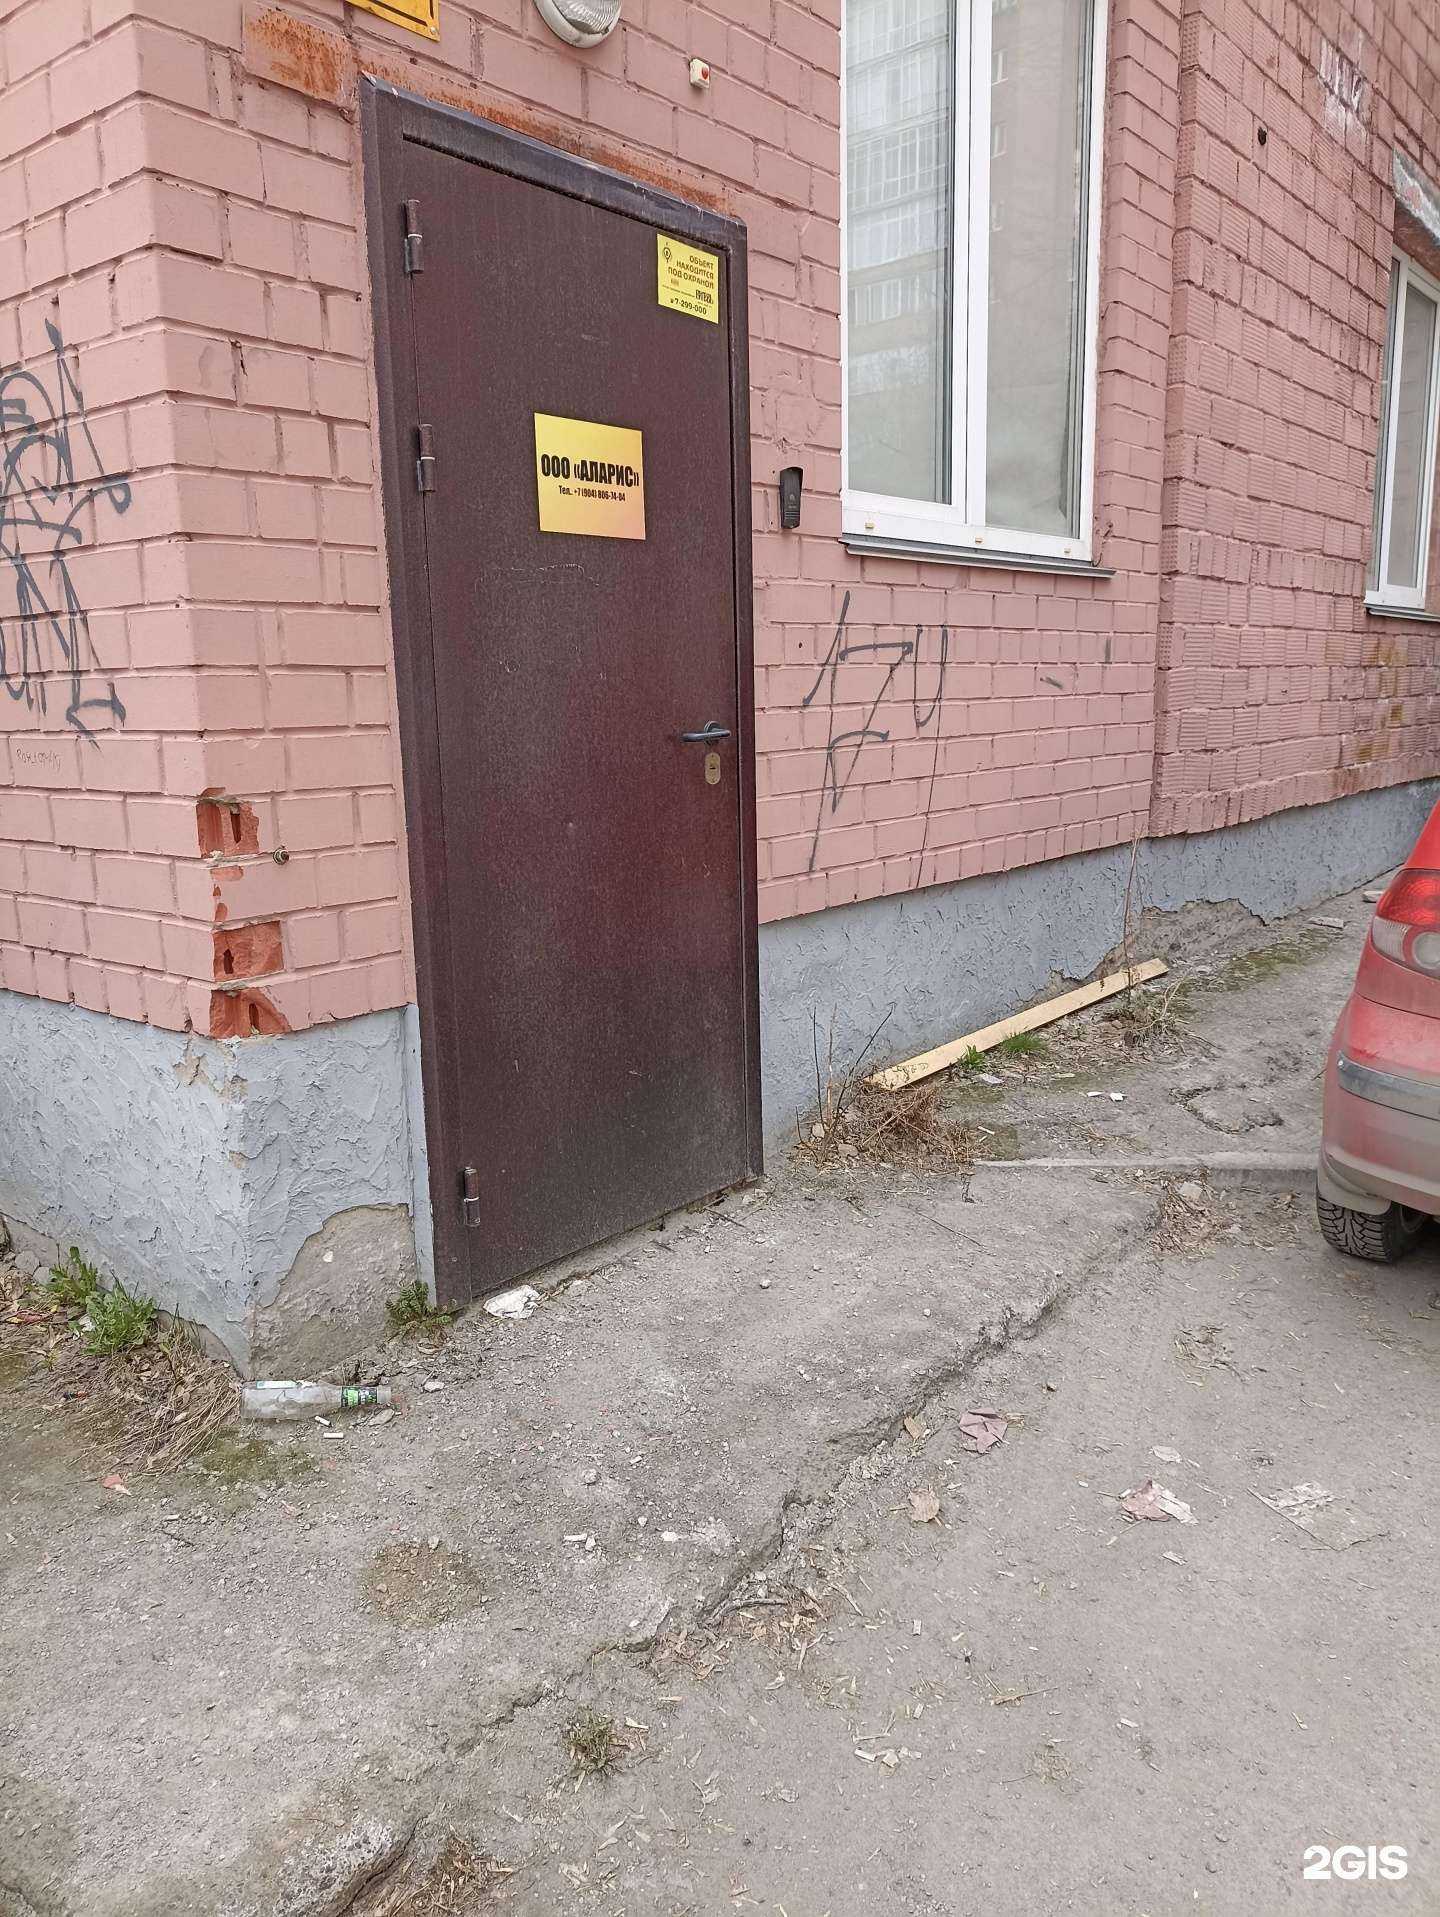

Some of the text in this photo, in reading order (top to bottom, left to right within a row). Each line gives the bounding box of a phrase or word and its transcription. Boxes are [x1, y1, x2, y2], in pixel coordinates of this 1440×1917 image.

[676, 260, 714, 280] НАХОДИТСЯ
[689, 255, 714, 270] ОБЪЕКТ
[667, 266, 682, 279] ПОД
[683, 272, 714, 289] ОХРАНОЙ
[540, 453, 640, 488] ООО «АЛАРИС»
